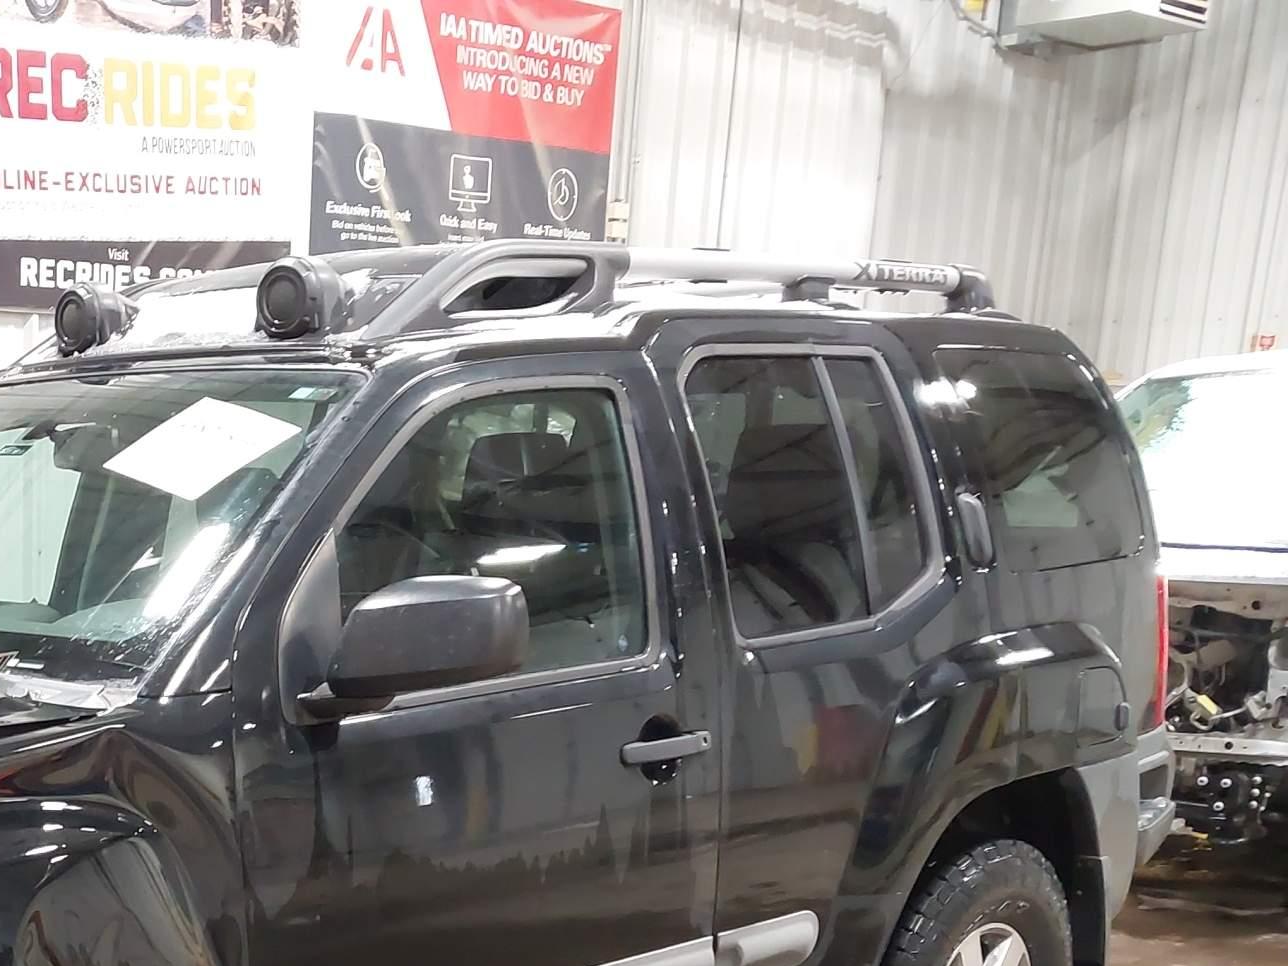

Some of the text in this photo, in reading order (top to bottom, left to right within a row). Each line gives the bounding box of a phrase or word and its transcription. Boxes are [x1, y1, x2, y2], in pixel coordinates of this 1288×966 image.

[440, 12, 467, 41] IAA
[469, 20, 523, 49] TIMED
[456, 44, 595, 85] INTRODUCING A NEW
[462, 70, 585, 106] WAY TO BID & BUY
[141, 136, 257, 157] A POWERSPORT AUCTION
[184, 175, 263, 196] AUCTION
[325, 200, 370, 217] Exclusive
[439, 213, 498, 233] Quick and Easy
[523, 223, 591, 240] Real-Time Updates
[108, 247, 130, 261] Visit
[854, 261, 947, 284] XTERRA
